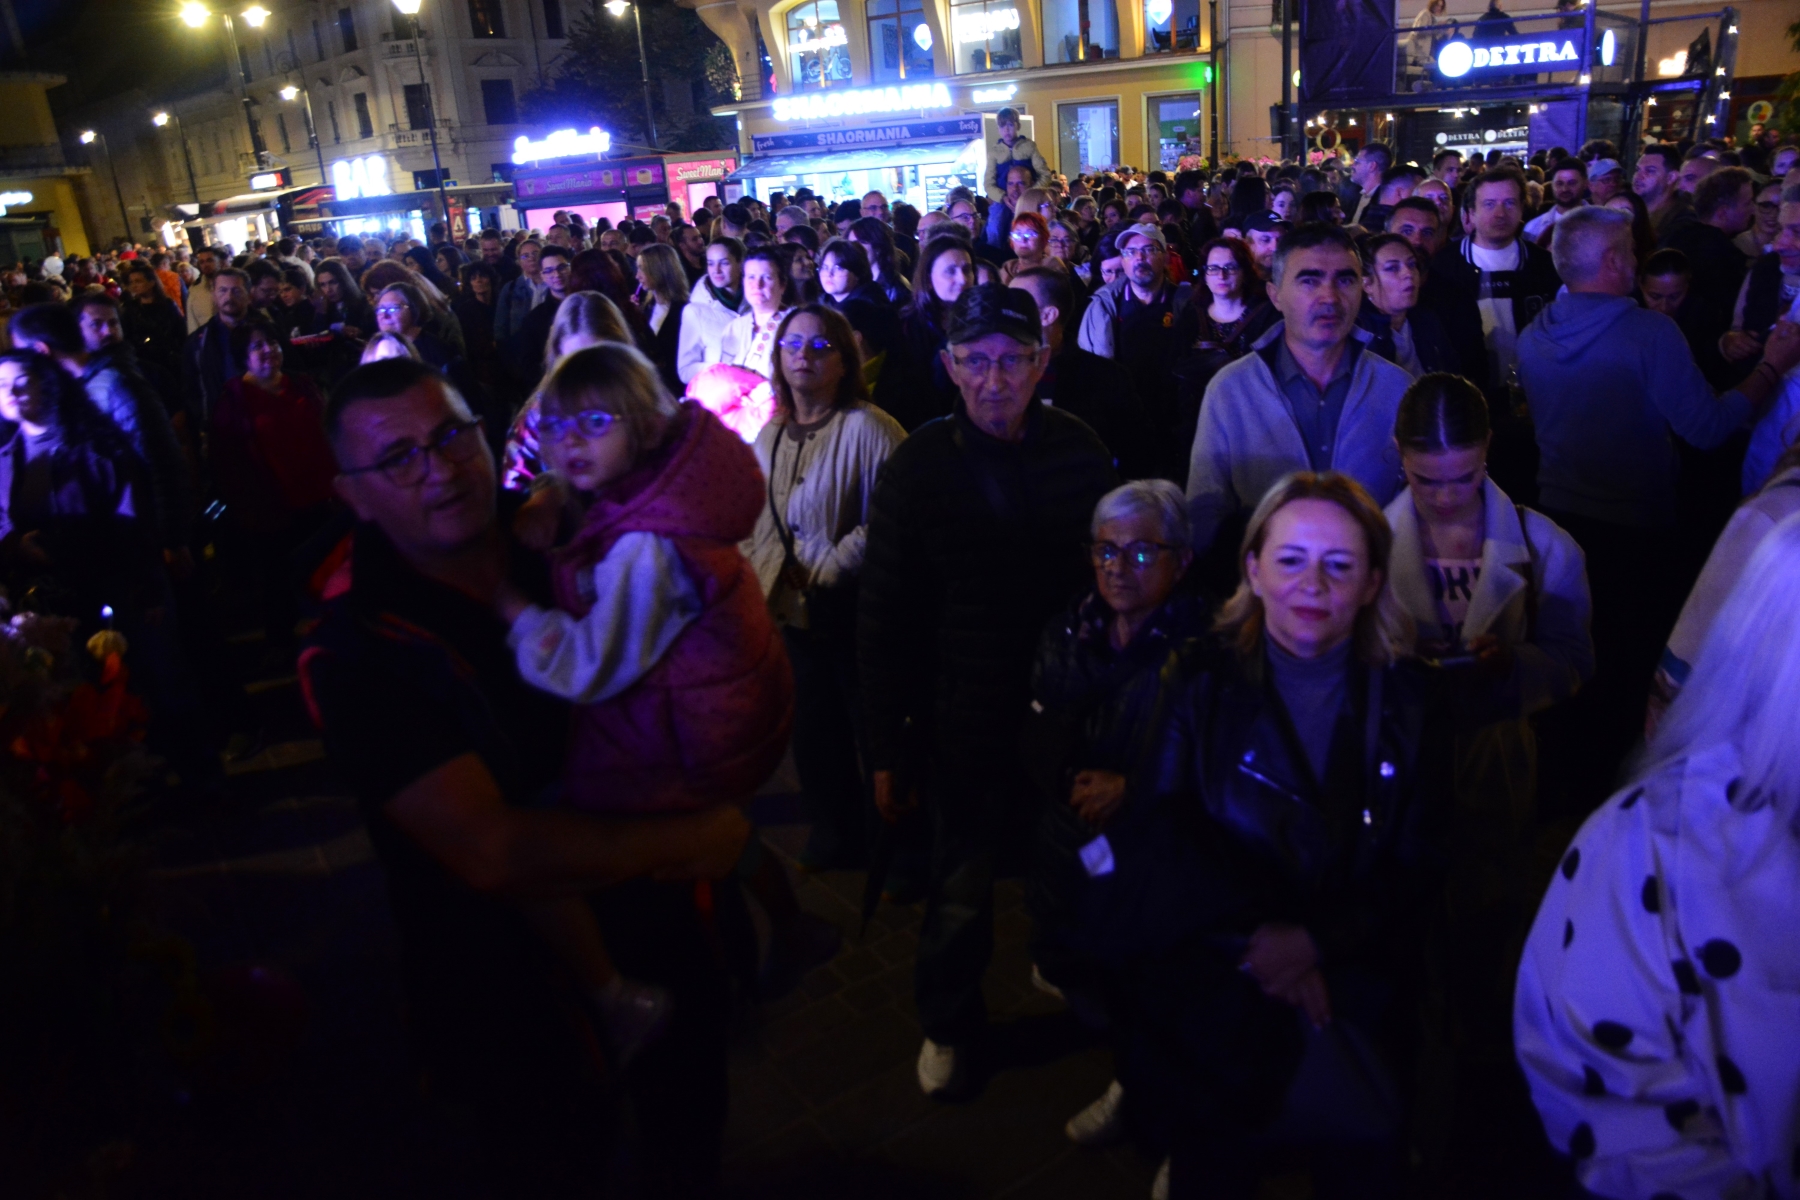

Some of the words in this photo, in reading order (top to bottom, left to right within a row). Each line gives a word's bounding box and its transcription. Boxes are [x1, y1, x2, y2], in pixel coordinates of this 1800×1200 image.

[1473, 40, 1580, 68] DEXTRA
[756, 137, 775, 151] fresh
[817, 126, 911, 146] SHAORMANIA
[958, 120, 979, 134] tasty
[333, 155, 391, 201] BAR
